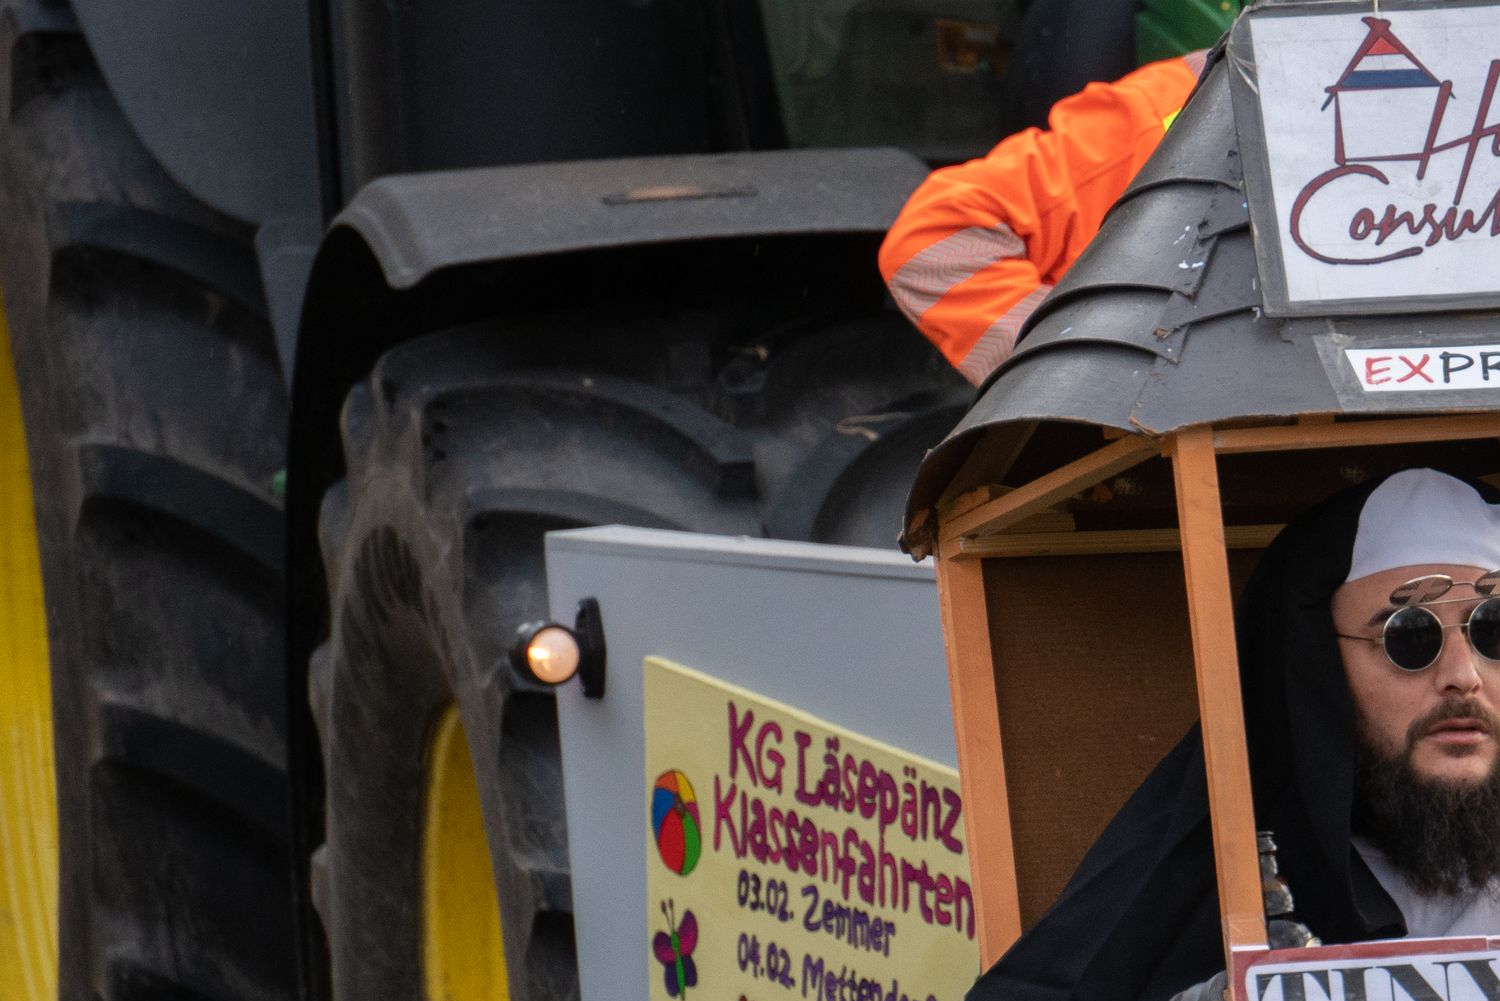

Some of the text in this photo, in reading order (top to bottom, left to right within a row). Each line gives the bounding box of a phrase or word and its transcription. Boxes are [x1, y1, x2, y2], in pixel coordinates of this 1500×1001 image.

[728, 701, 963, 855] KG Läsepänz
[713, 775, 976, 941] Klassenfahrten
[737, 869, 896, 958] 03.02. Zemmer
[737, 932, 796, 990] 04.02.
